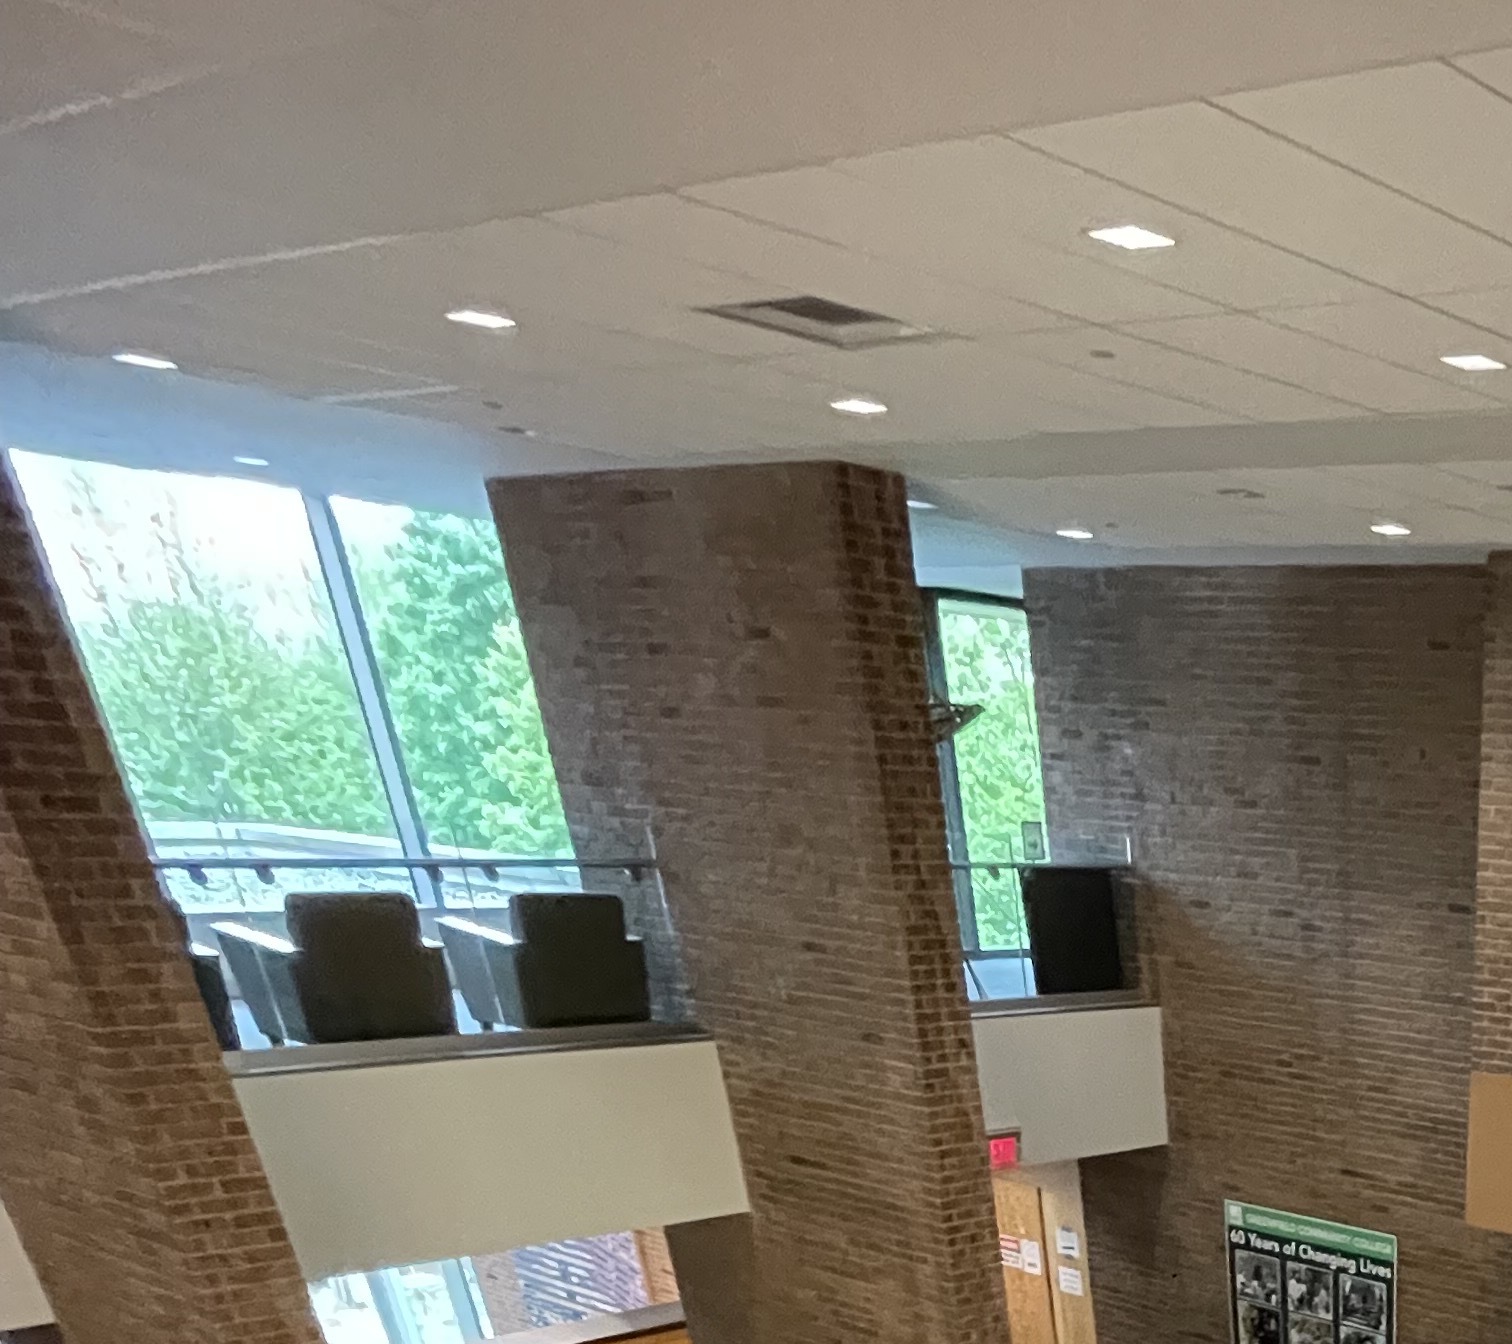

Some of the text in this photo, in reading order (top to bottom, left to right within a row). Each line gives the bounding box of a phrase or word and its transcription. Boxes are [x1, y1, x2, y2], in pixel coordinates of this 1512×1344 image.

[1230, 1229, 1245, 1244] 60
[1247, 1232, 1280, 1253] Years
[1282, 1241, 1296, 1256] of
[1298, 1244, 1356, 1274] Changing
[1360, 1257, 1392, 1279] Lives
